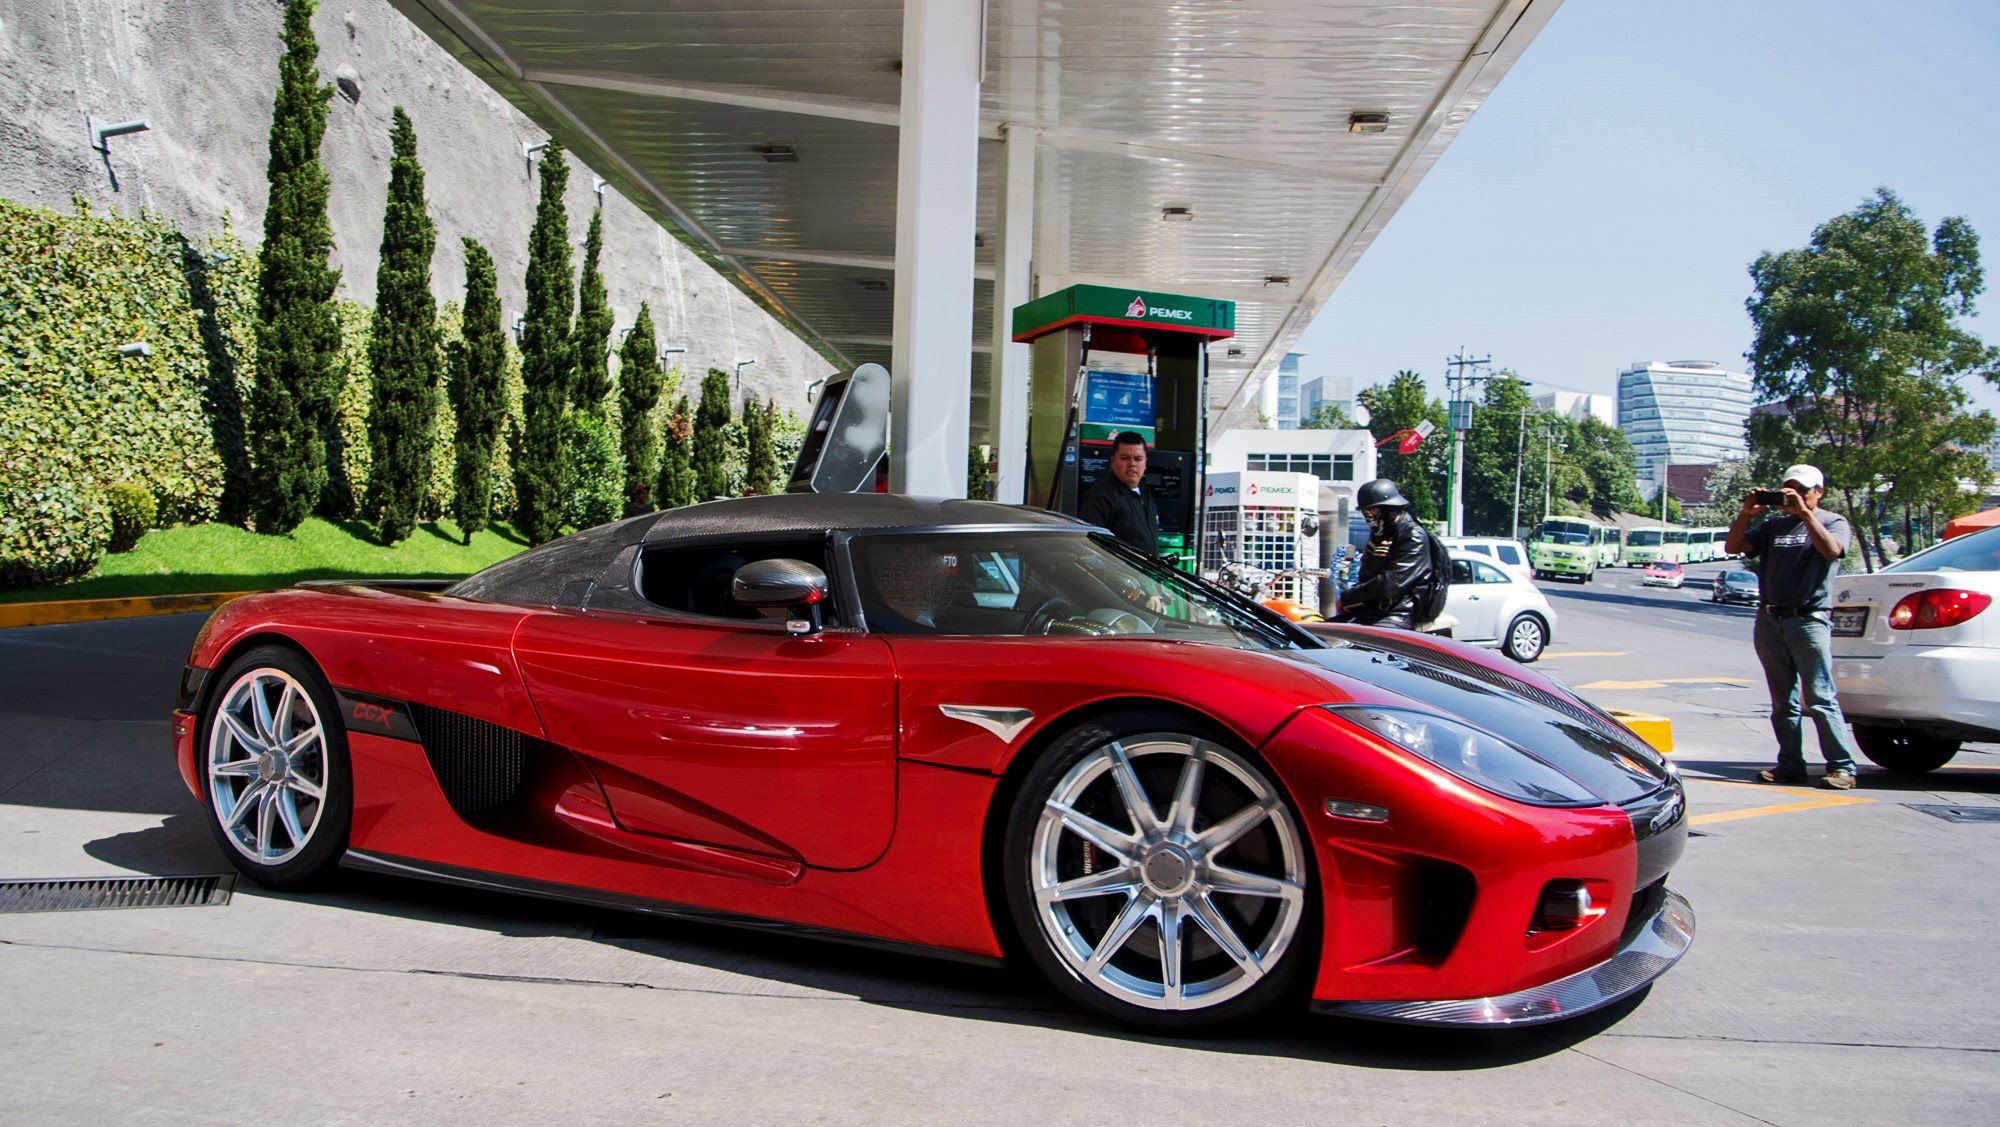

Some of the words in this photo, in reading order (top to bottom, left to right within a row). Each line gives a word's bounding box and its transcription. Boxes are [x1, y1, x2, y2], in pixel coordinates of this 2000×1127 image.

[1149, 307, 1192, 320] PEMEX
[1208, 300, 1228, 328] 11
[1214, 486, 1237, 494] PEMEX
[1260, 486, 1293, 494] PEMEX
